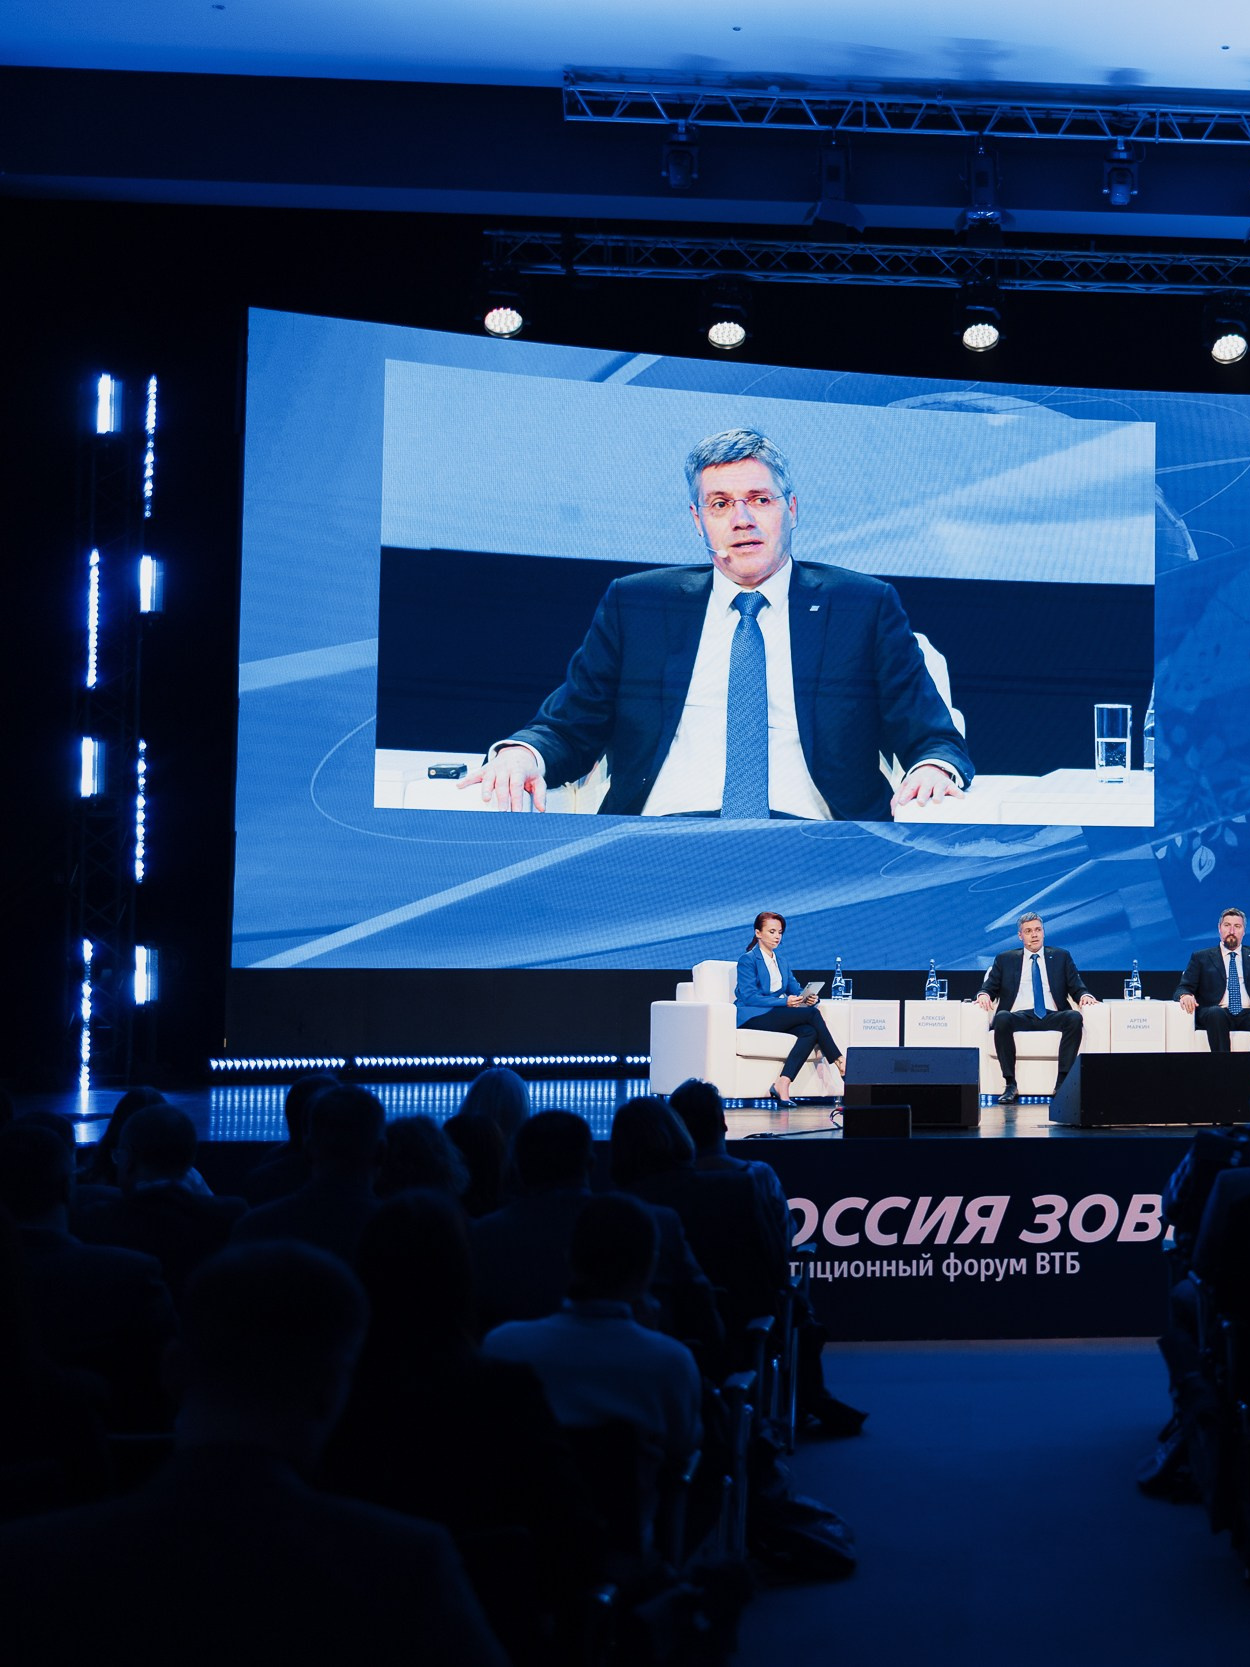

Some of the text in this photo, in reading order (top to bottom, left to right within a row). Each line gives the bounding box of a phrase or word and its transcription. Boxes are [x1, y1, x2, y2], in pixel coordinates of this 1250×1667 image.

[787, 1194, 1175, 1247] ОССИЯ ЗОВ
[942, 1252, 1026, 1282] форум
[1037, 1252, 1080, 1274] ВТБ
